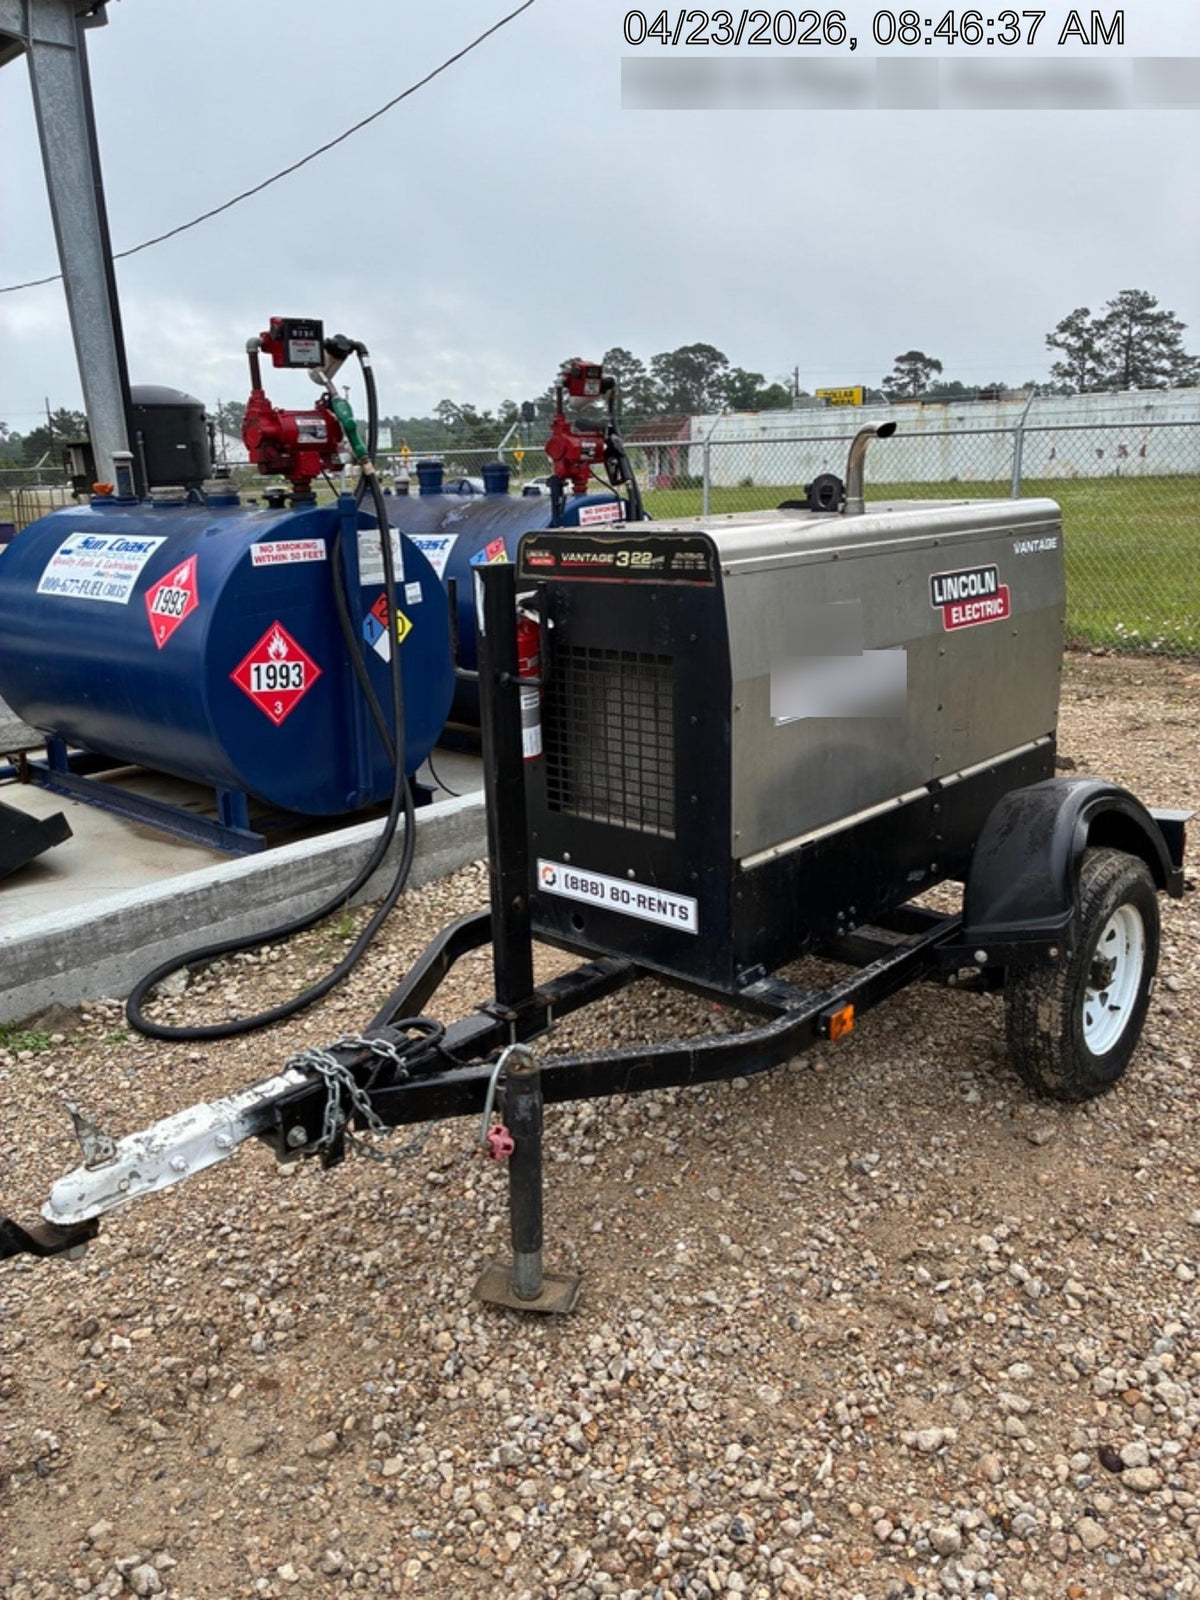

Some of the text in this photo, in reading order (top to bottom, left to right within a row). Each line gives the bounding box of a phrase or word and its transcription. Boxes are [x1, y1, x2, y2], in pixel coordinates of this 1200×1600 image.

[82, 536, 156, 553] Sun Coast
[259, 542, 317, 553] NO SMOKING
[1013, 537, 1058, 555] VANTAGE
[254, 550, 324, 564] WITHIN 50 FEET
[561, 552, 614, 563] VANTAGE
[616, 551, 653, 567] 322
[933, 570, 996, 603] LINCOLN
[154, 588, 188, 616] 1993
[951, 598, 1004, 624] ELECTRIC
[367, 620, 375, 639] 1
[253, 663, 303, 691] 1993
[274, 701, 283, 715] 3
[564, 873, 689, 920] (888) 80-RENTS
